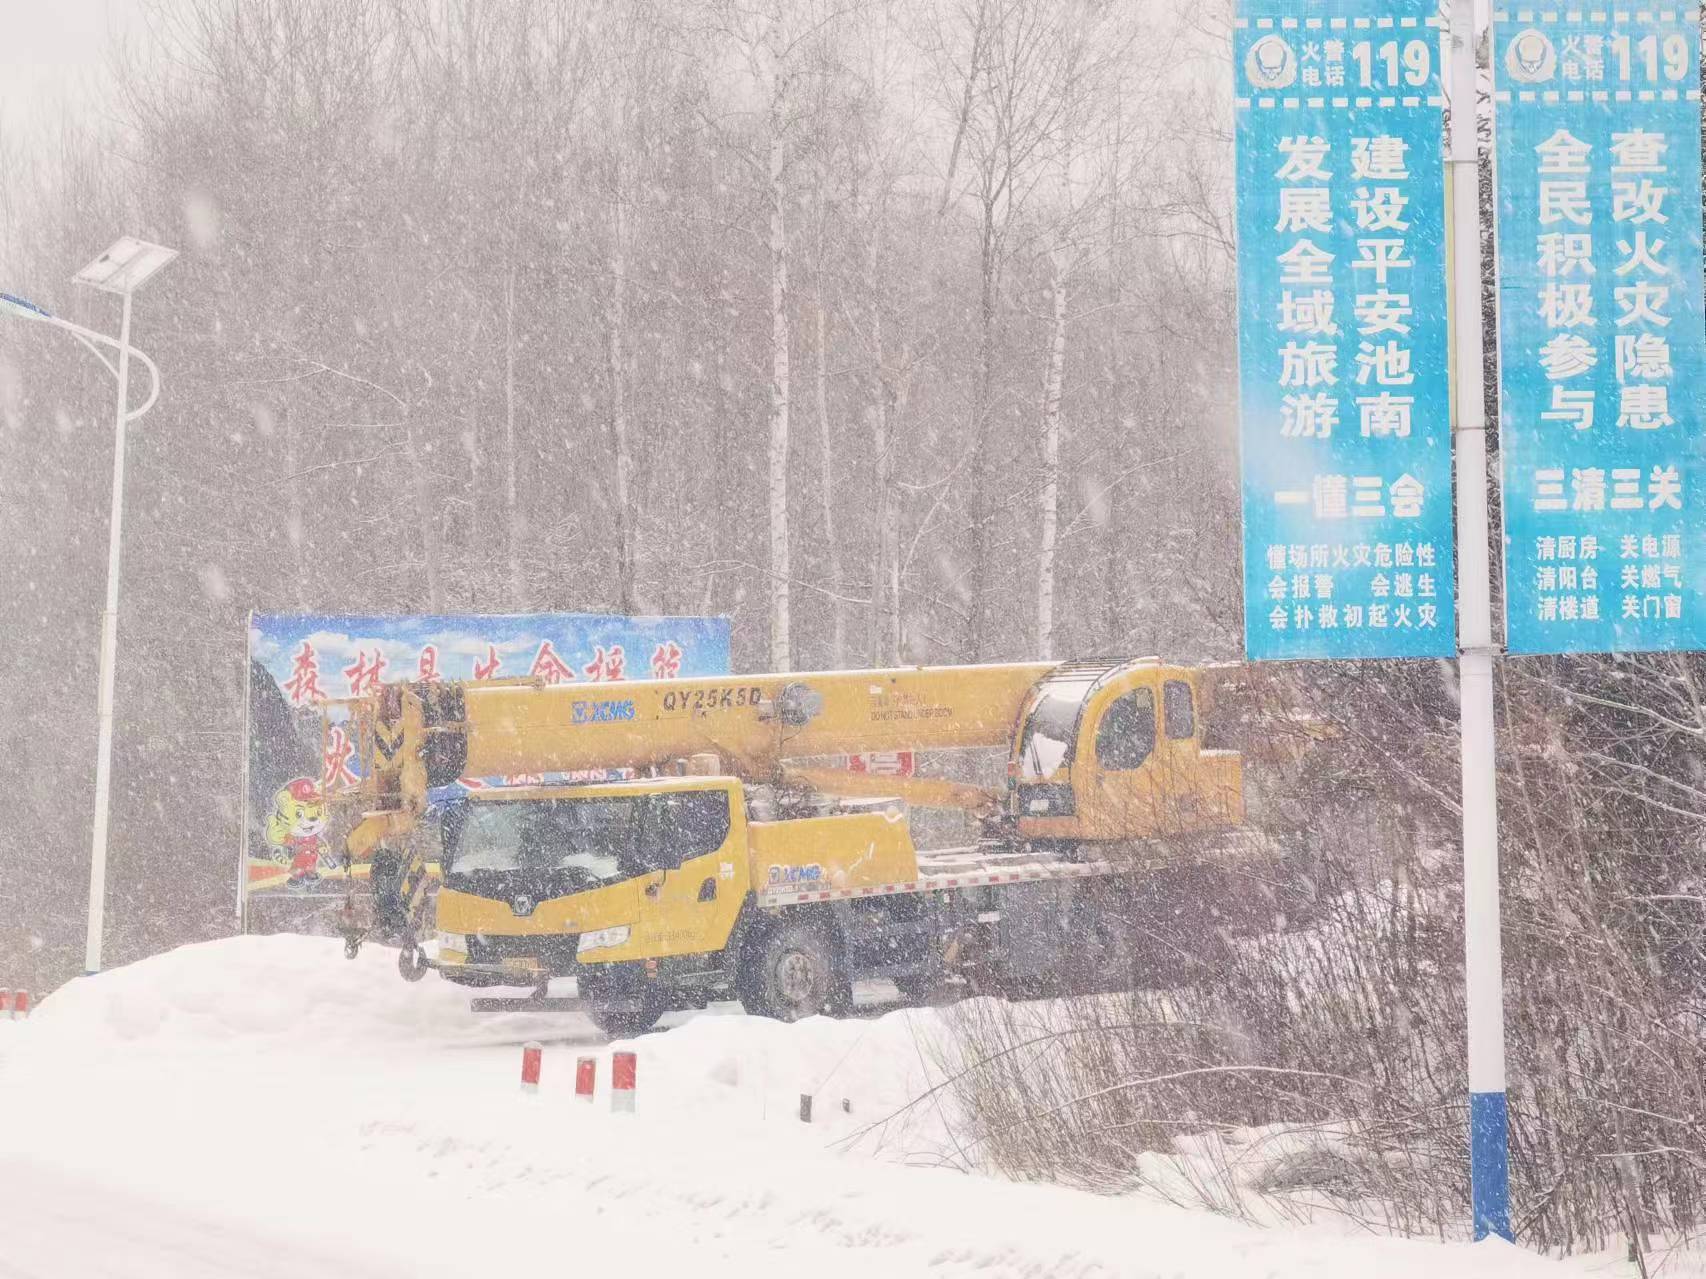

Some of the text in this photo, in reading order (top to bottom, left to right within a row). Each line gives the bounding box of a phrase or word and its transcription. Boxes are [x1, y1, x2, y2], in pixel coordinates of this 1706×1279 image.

[1301, 40, 1430, 87] 火警 119
[1302, 65, 1344, 86] 电话
[1562, 60, 1604, 80] 电话
[1613, 34, 1688, 81] 119
[1274, 135, 1339, 438] 发展全域旅游
[1350, 134, 1414, 437] 建设平安池南
[1534, 129, 1598, 430] 全民积极参与
[1610, 128, 1675, 430] 查改火灾隐患
[1274, 473, 1425, 518] 一懂三会
[1534, 465, 1682, 511] 三清三关
[1267, 542, 1436, 569] 懂场所火灾危险性
[1536, 534, 1681, 560] 清厨房 关电源
[1268, 572, 1437, 600] 会报警 会逃生
[1537, 564, 1682, 591] 清阳台 关燃气
[1269, 602, 1437, 629] 会扑救初起火灾
[1538, 593, 1682, 621] 清楼道 关门窗
